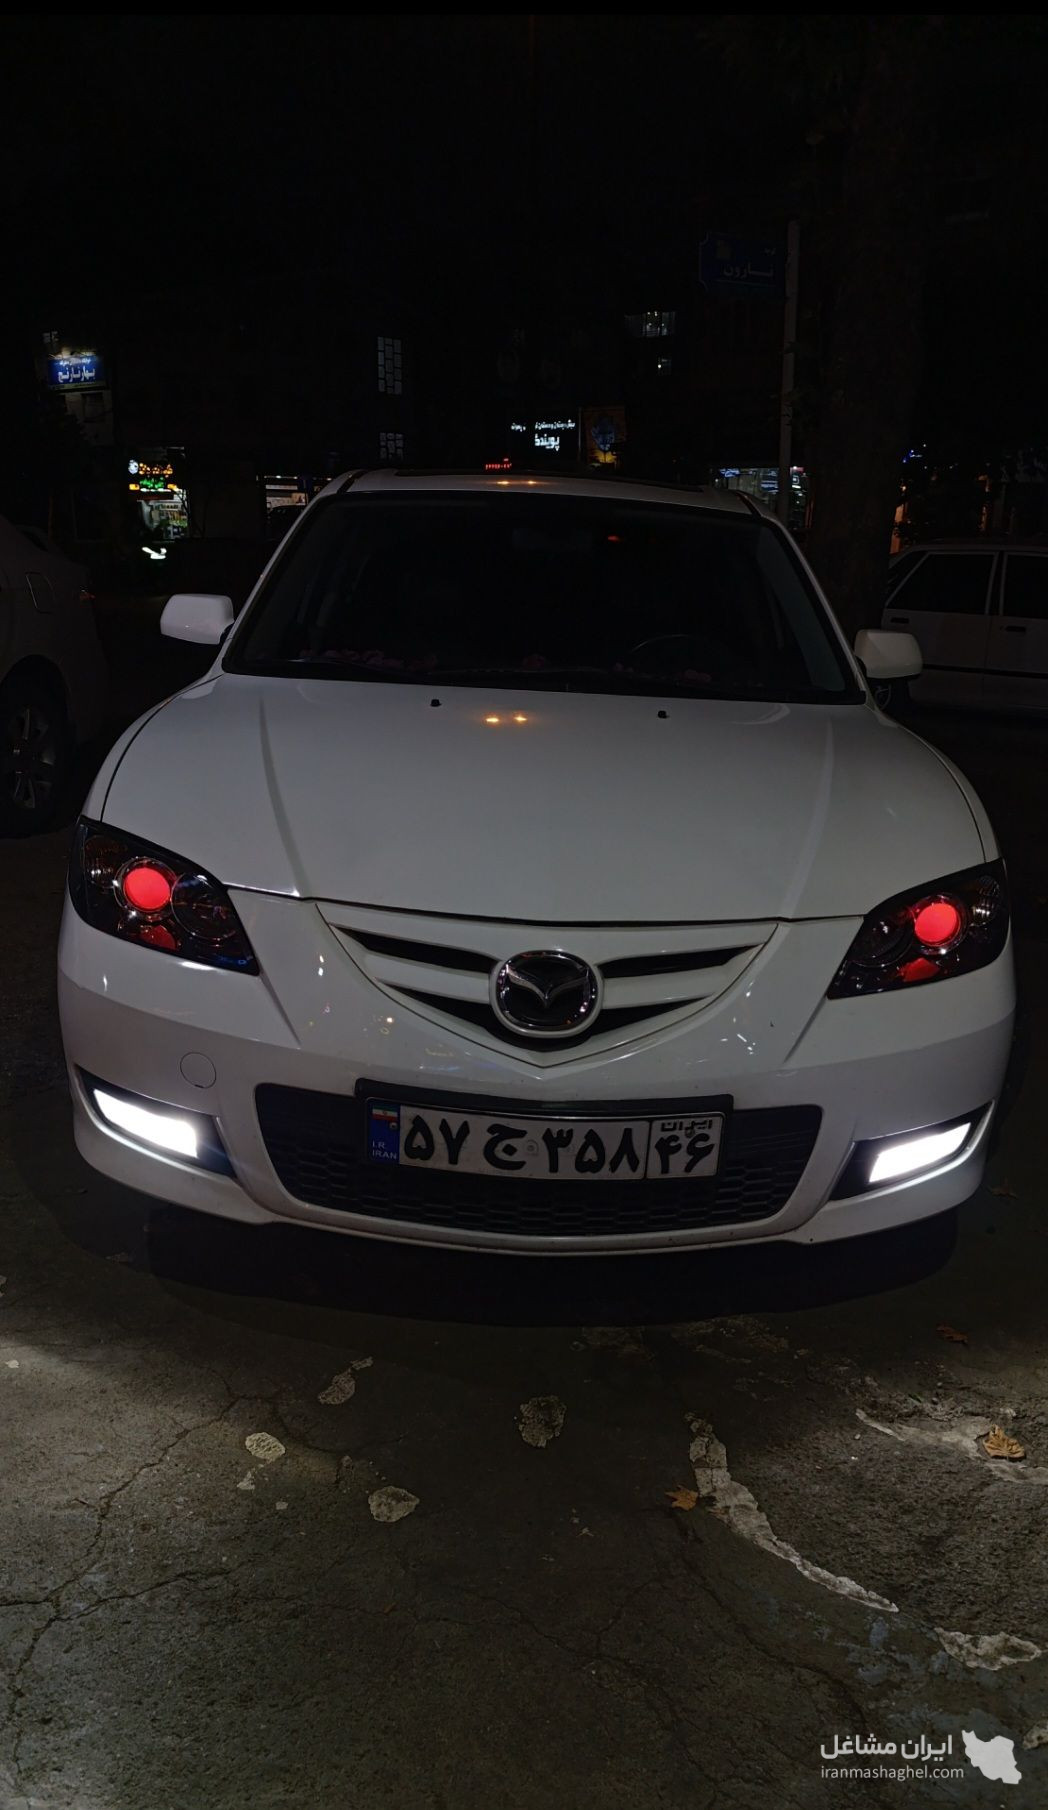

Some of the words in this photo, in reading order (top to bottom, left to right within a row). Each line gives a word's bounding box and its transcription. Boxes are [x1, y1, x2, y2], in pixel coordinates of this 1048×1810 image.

[661, 1119, 713, 1134] ایران
[372, 1149, 398, 1160] IRAN
[404, 1115, 470, 1165] ۵۷
[483, 1123, 528, 1170] ج
[542, 1128, 640, 1173] ۳۵۸
[655, 1133, 715, 1174] ۴۶
